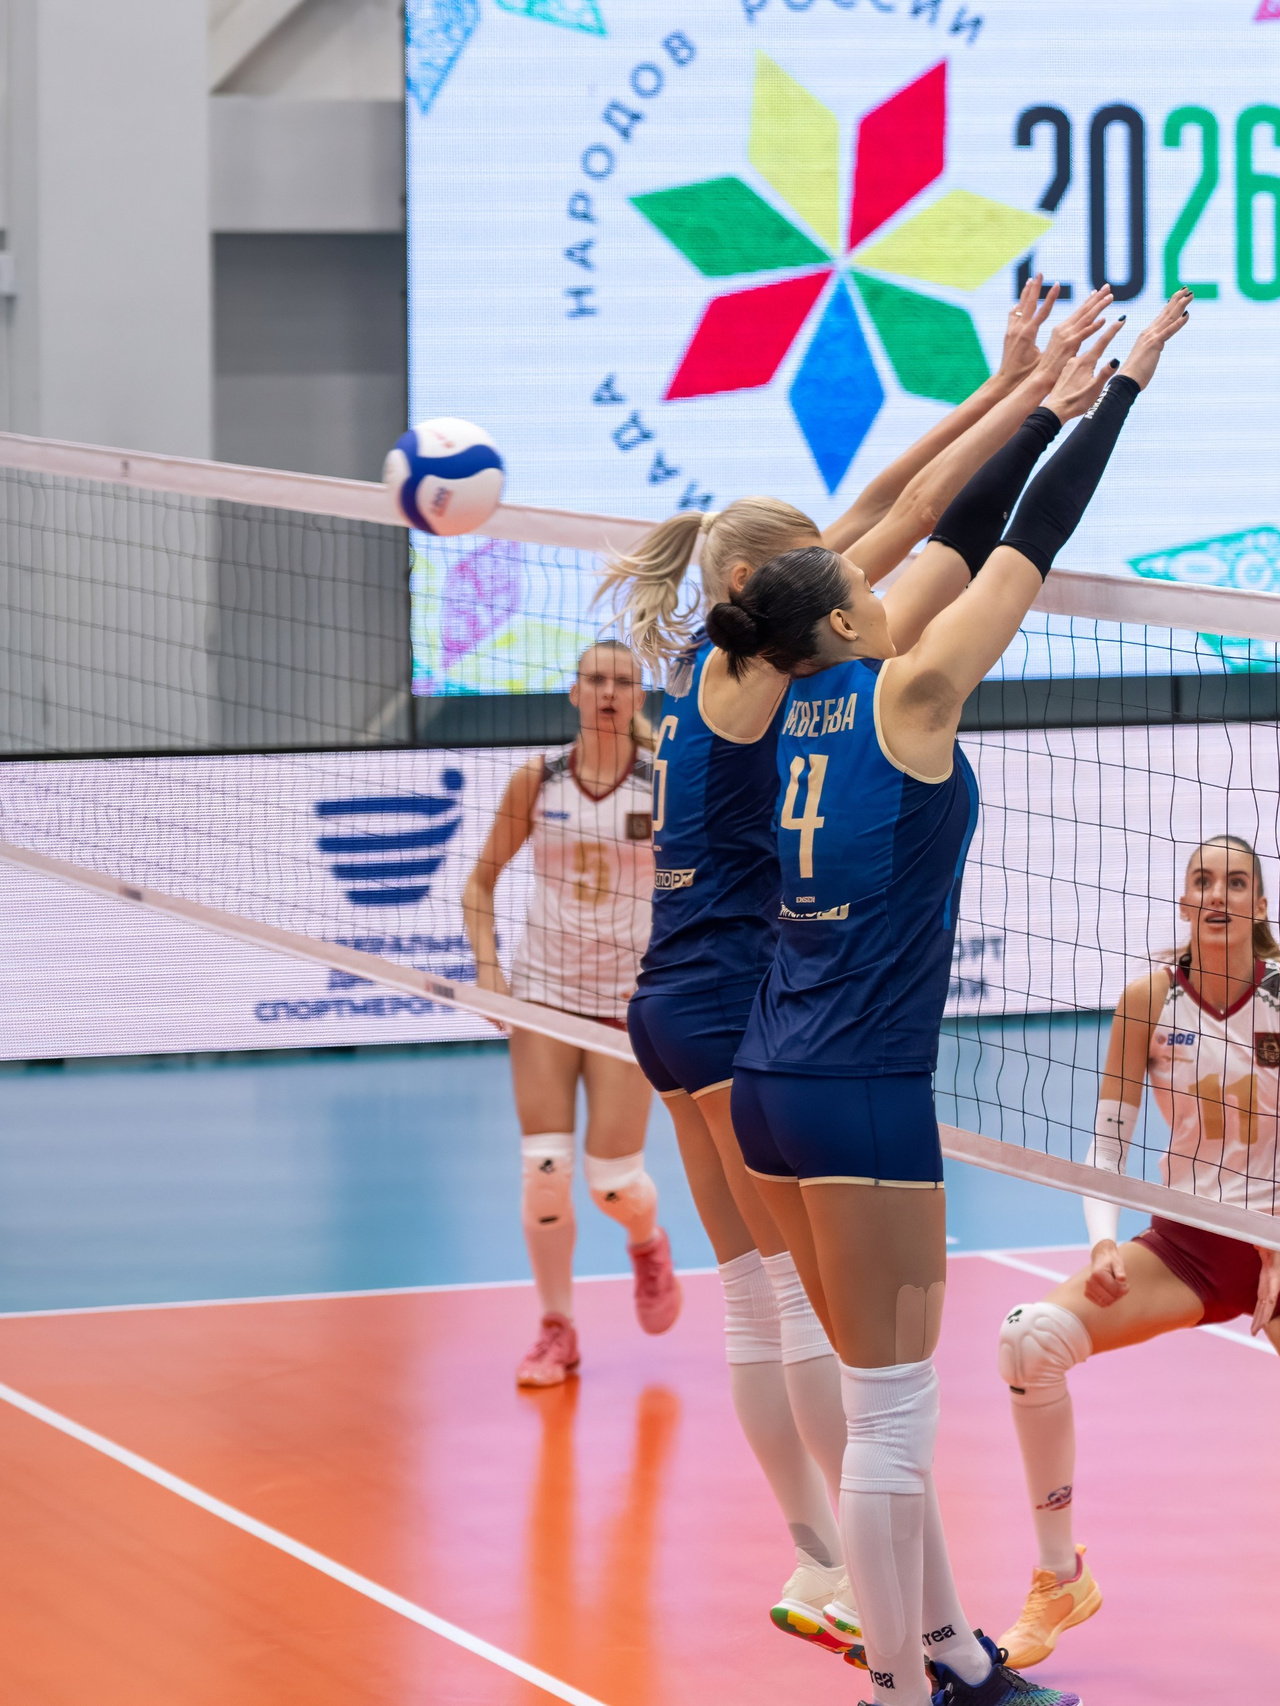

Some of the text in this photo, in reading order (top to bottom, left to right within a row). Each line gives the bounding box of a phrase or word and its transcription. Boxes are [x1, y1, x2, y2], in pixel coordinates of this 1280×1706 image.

[566, 30, 697, 318] НАРОДОВ
[780, 753, 829, 878] 4
[1188, 1073, 1258, 1145] 11
